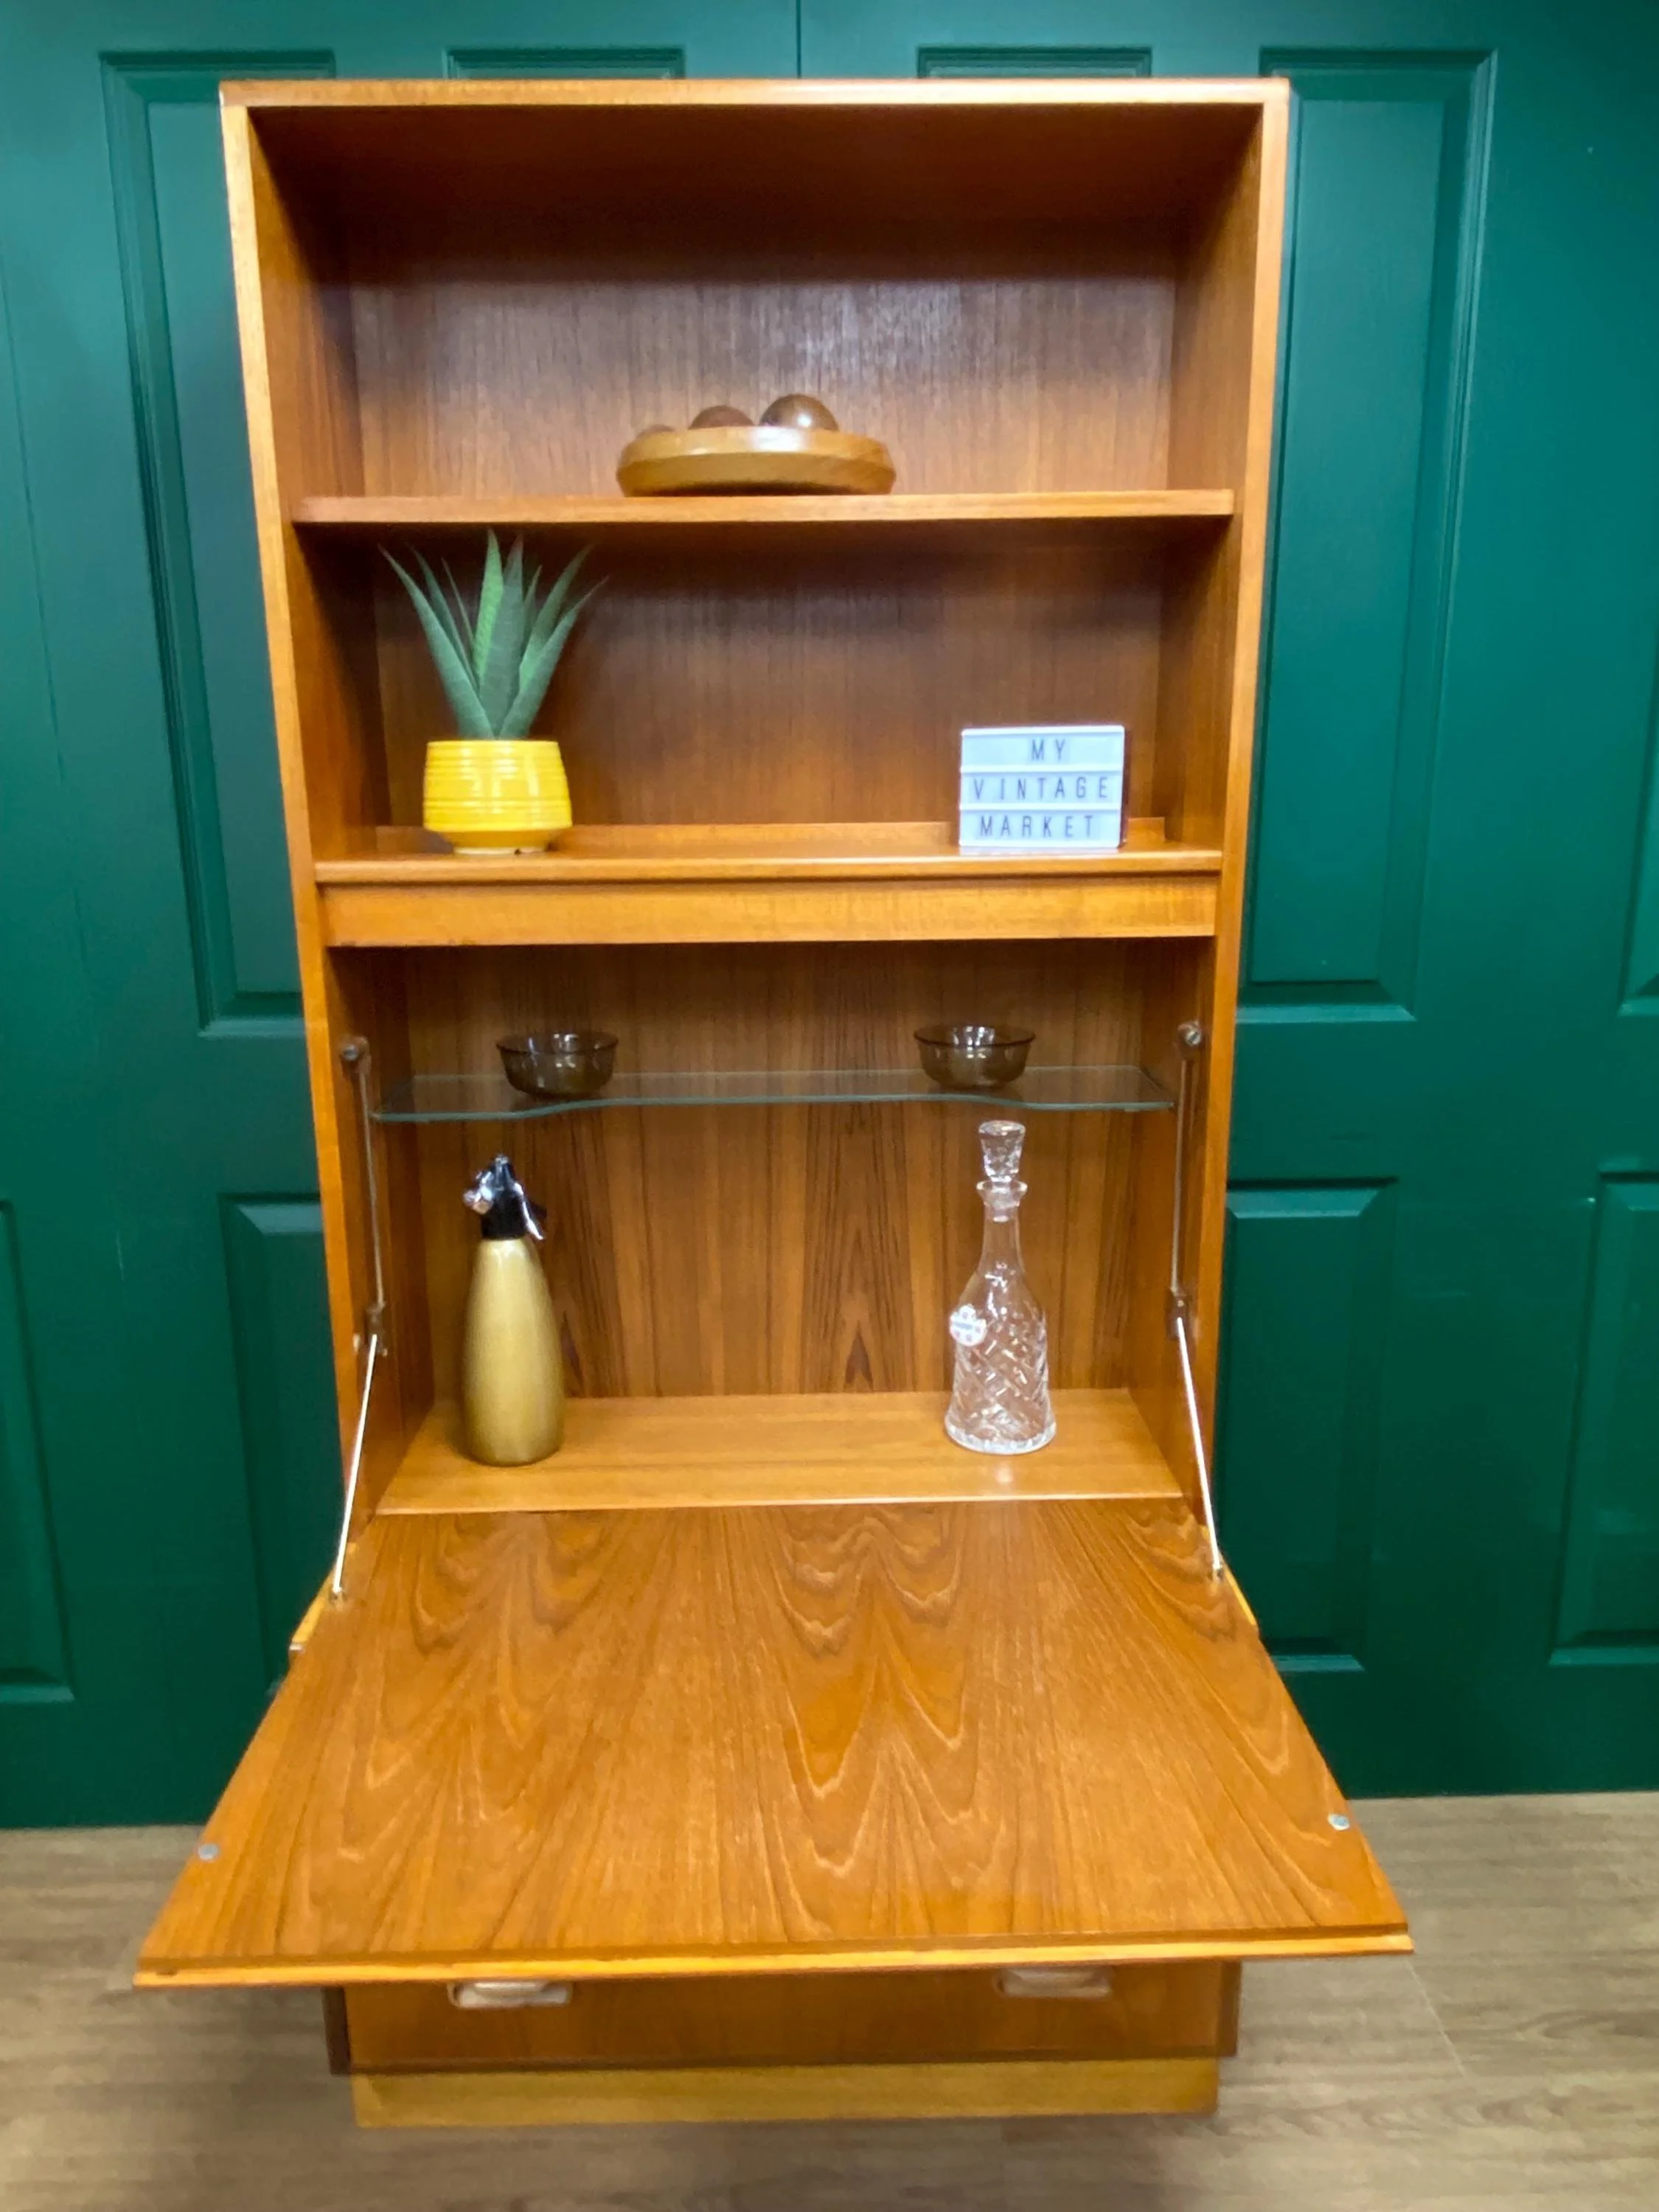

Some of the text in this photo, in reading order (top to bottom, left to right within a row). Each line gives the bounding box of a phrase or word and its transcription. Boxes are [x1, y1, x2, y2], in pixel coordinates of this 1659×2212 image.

[1032, 739, 1065, 761] MY
[973, 776, 1107, 800] VINTAGE
[980, 815, 1093, 838] MARKET
